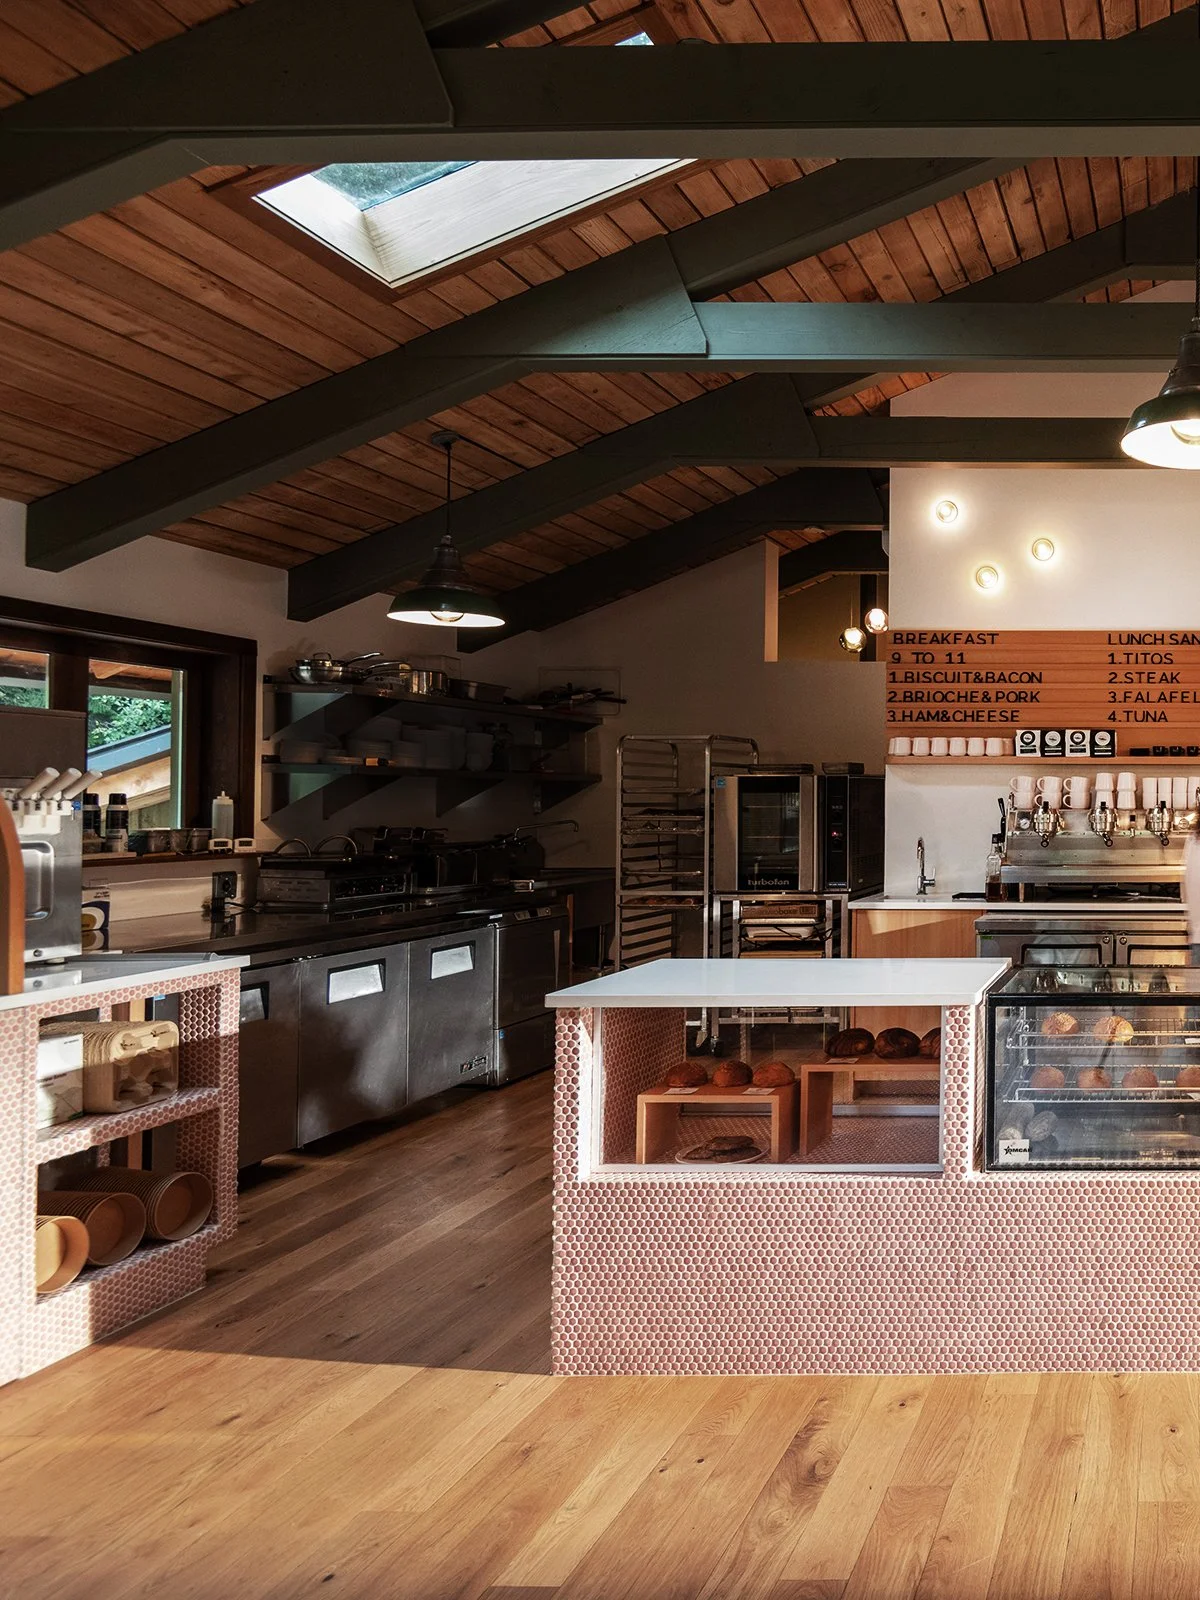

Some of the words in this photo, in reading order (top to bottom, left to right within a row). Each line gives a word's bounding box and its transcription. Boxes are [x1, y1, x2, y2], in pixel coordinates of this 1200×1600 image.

[893, 632, 999, 645] BREAKFAST
[1107, 633, 1165, 646] LUNCH
[891, 652, 902, 665] 9
[912, 652, 935, 665] TO
[945, 652, 966, 665] 11
[1107, 652, 1174, 665] 1.TITOS
[888, 671, 1043, 684] 1.BISCUIT&BACON
[1107, 671, 1181, 684] 2.STEAK
[886, 710, 1020, 723] 3.HAM&CHEESE
[1107, 710, 1169, 723] 4.TUNA
[747, 878, 790, 886] turbofan
